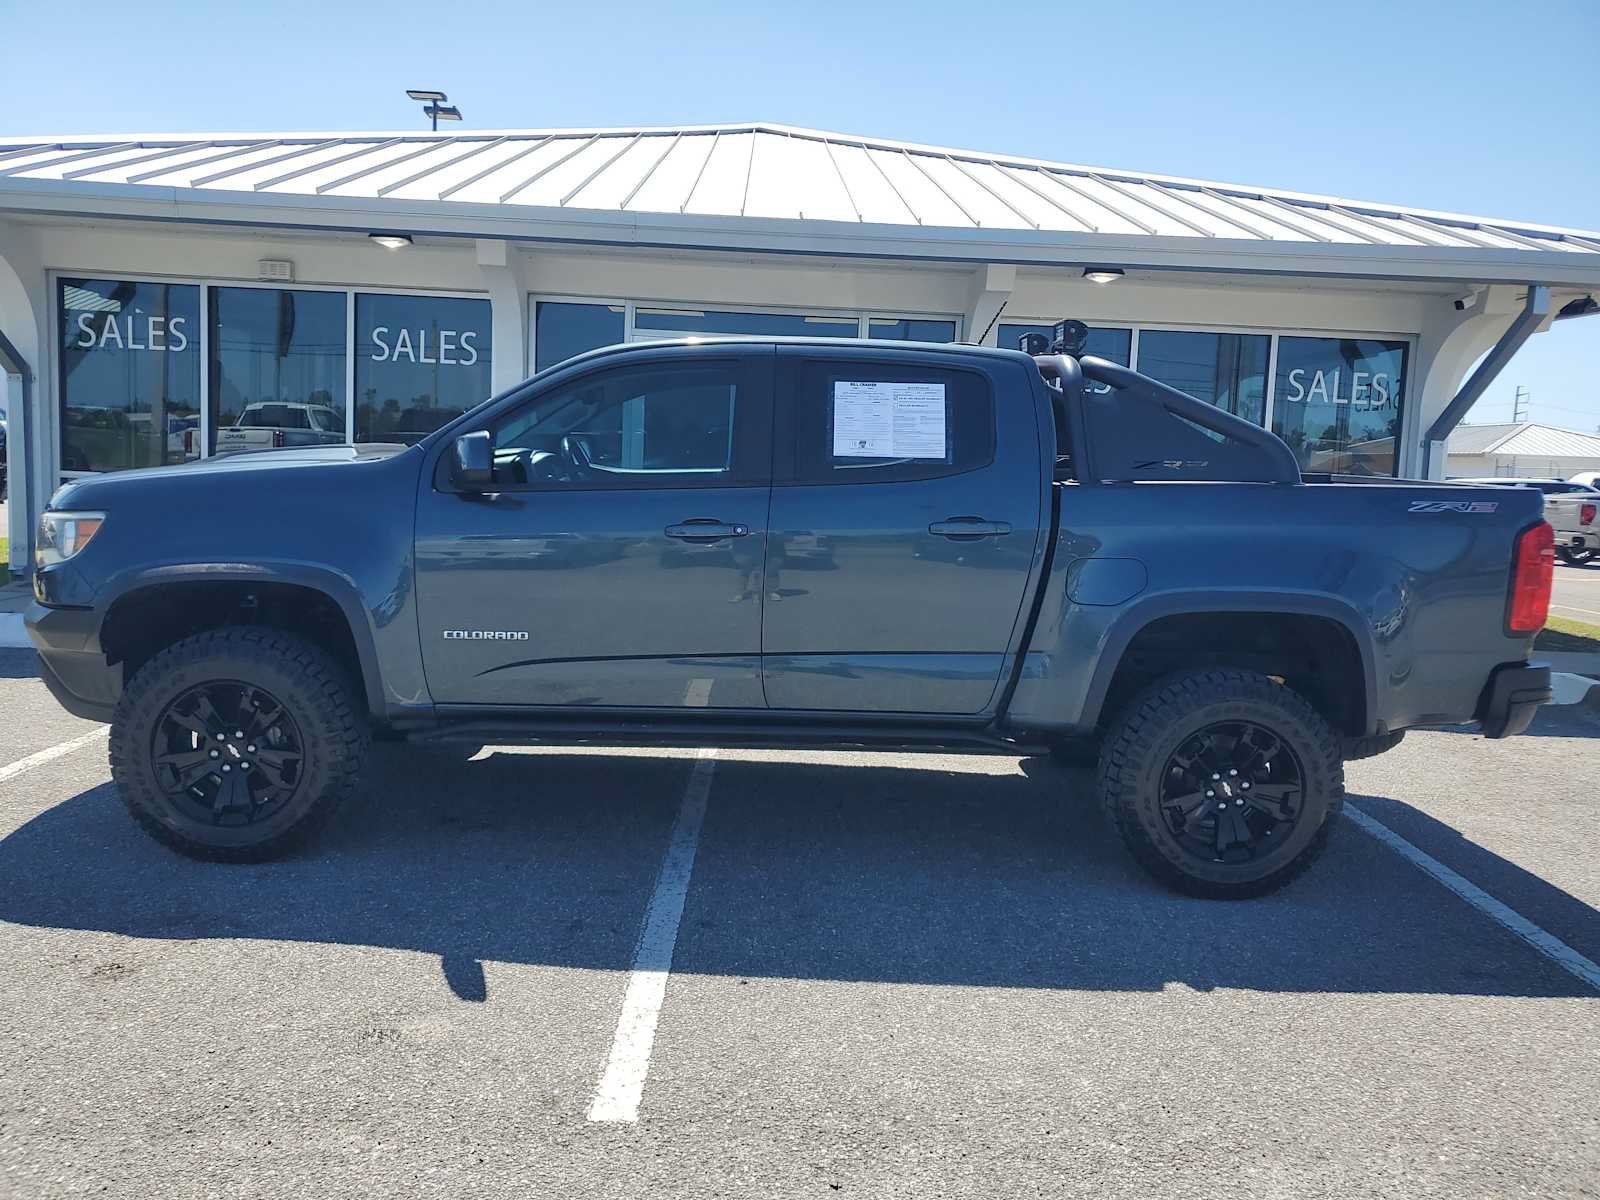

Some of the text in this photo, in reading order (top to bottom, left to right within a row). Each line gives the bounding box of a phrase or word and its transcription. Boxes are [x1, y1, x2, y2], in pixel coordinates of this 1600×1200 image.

[78, 312, 187, 351] SALES
[371, 327, 478, 366] SALES
[1287, 368, 1388, 406] SALES
[1407, 500, 1499, 513] ZR2
[443, 630, 529, 641] COLORADO
